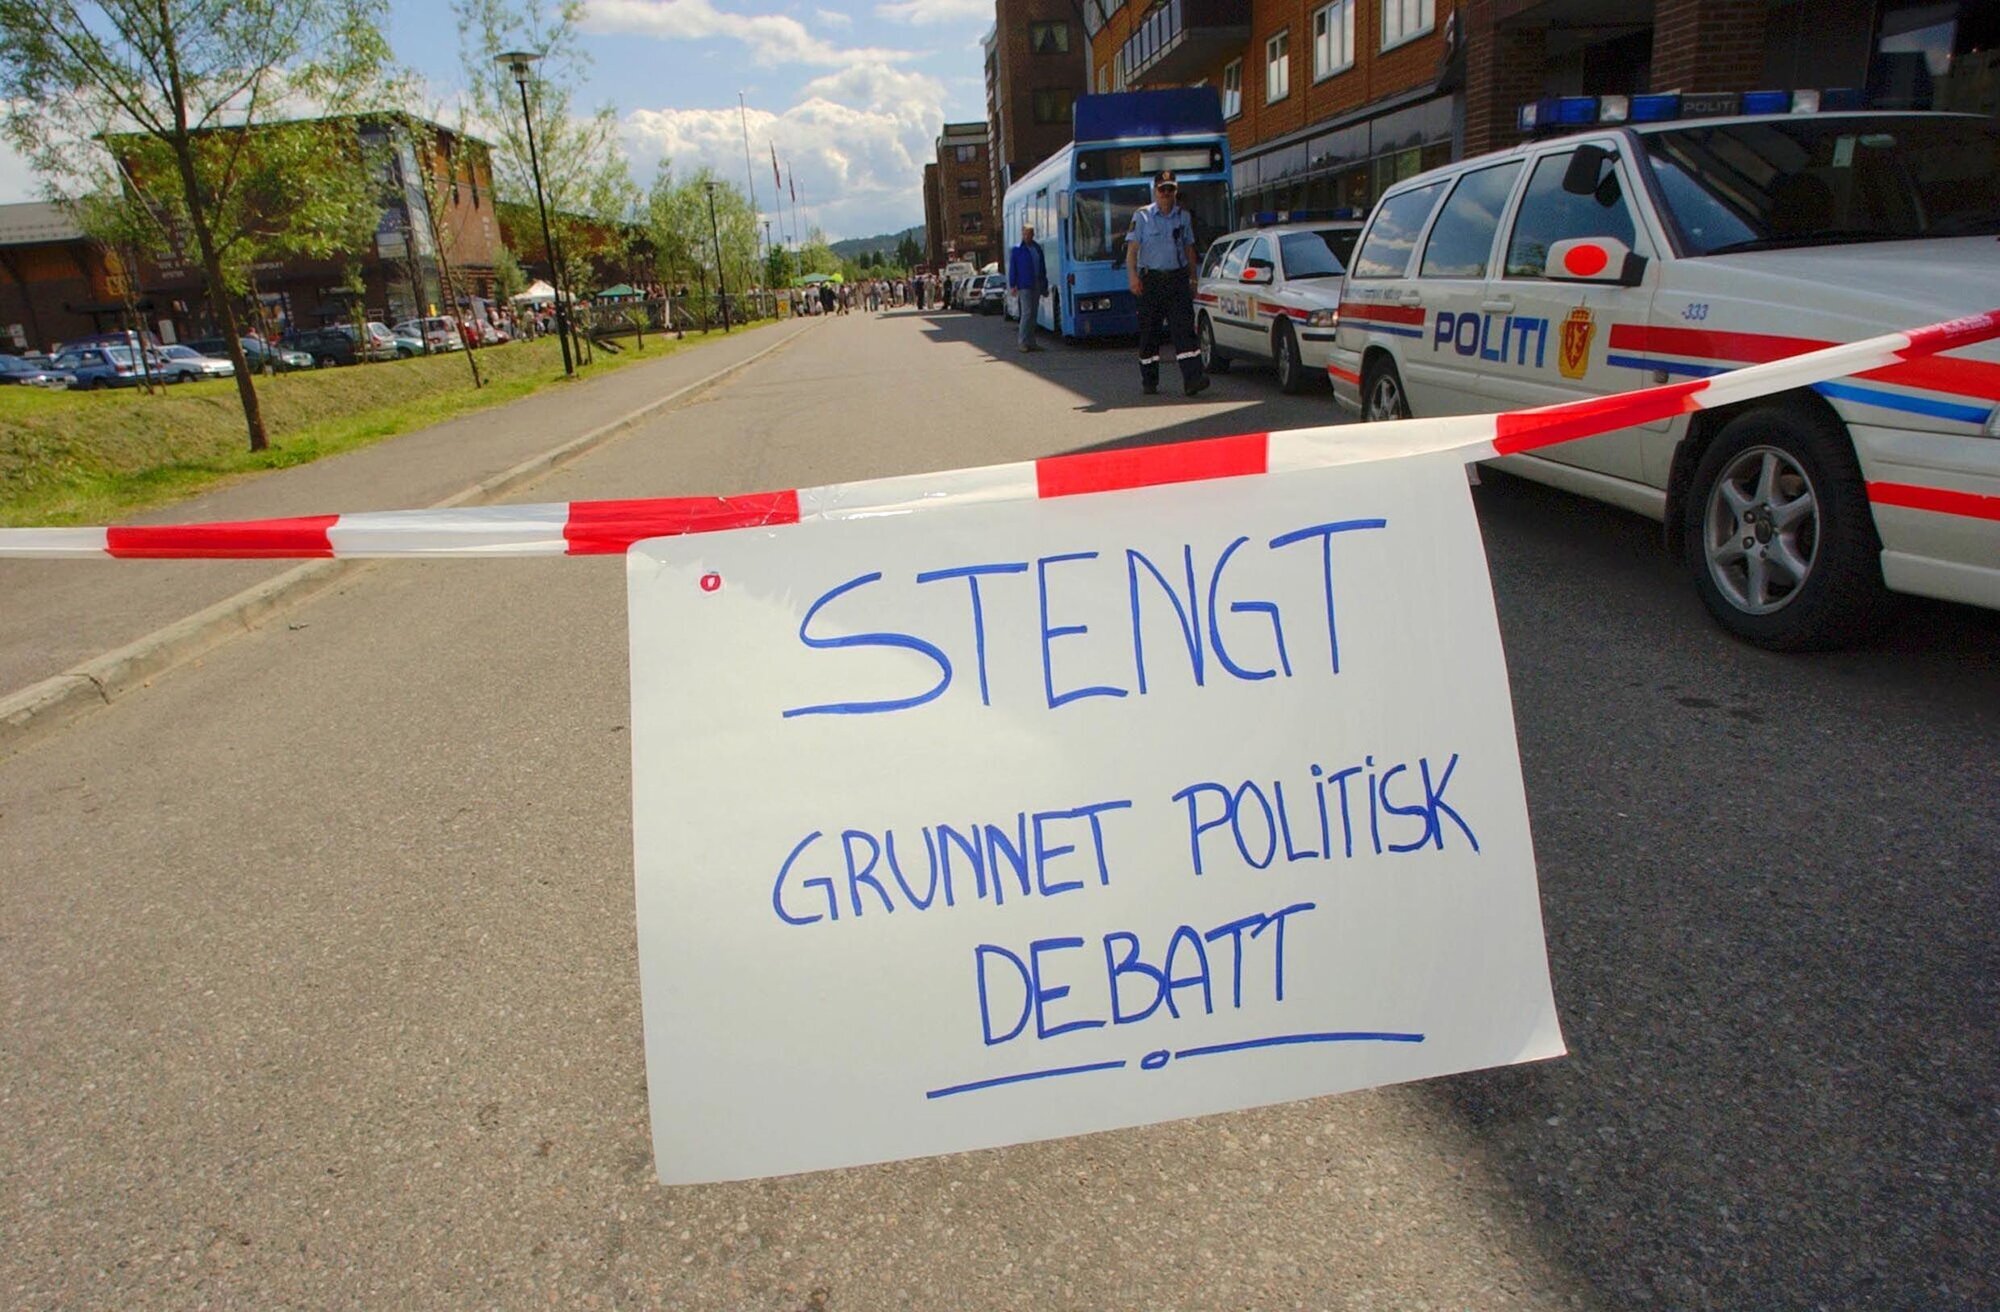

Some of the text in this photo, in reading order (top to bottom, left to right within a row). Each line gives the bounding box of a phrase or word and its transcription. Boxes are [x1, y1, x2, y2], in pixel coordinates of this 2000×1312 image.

[1683, 100, 1738, 113] POLITI
[1433, 311, 1549, 369] POLITI
[782, 518, 1387, 718] STENGT
[772, 799, 1132, 926] GRUNNET
[976, 903, 1316, 1047] DEBATT
